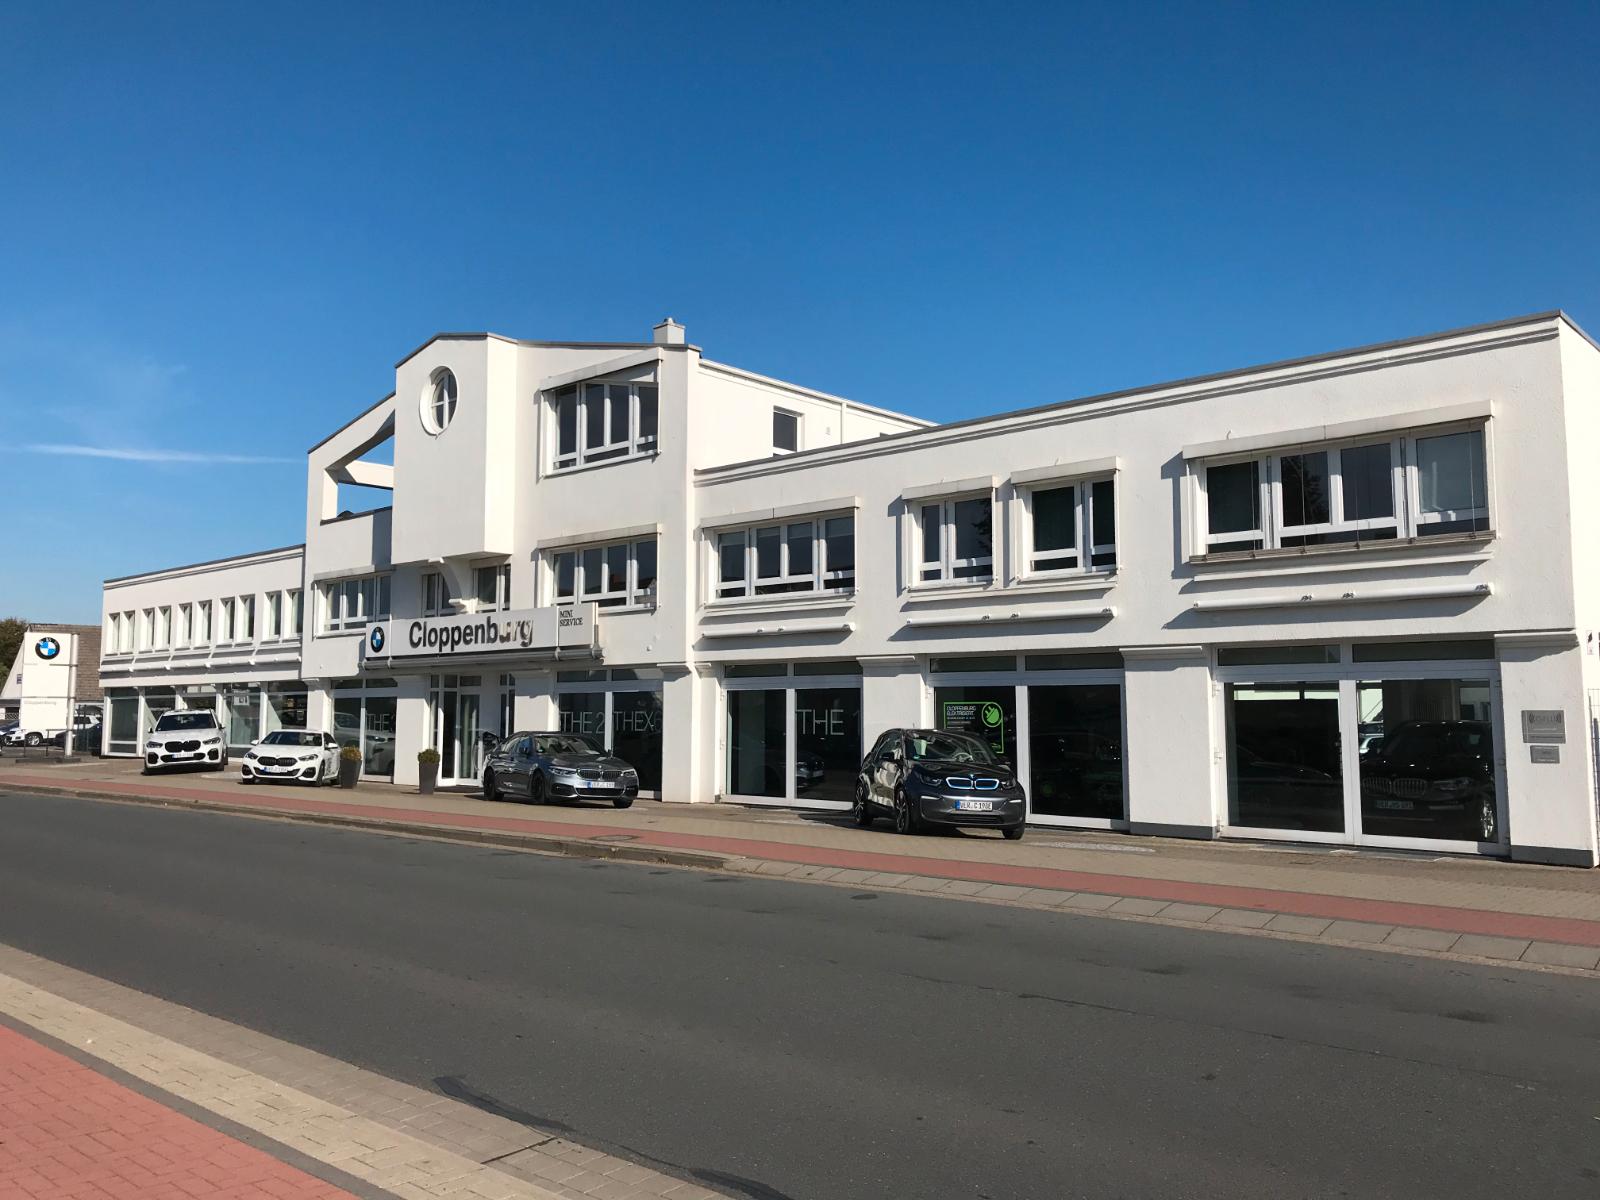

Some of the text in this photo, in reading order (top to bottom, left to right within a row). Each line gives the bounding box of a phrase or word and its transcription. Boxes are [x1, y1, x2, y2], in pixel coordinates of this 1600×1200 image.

[559, 609, 574, 619] MINI
[559, 617, 584, 627] SERVICE
[409, 616, 534, 653] Cloppenburg
[366, 713, 390, 732] THE
[560, 711, 593, 734] THE
[796, 709, 845, 736] THE
